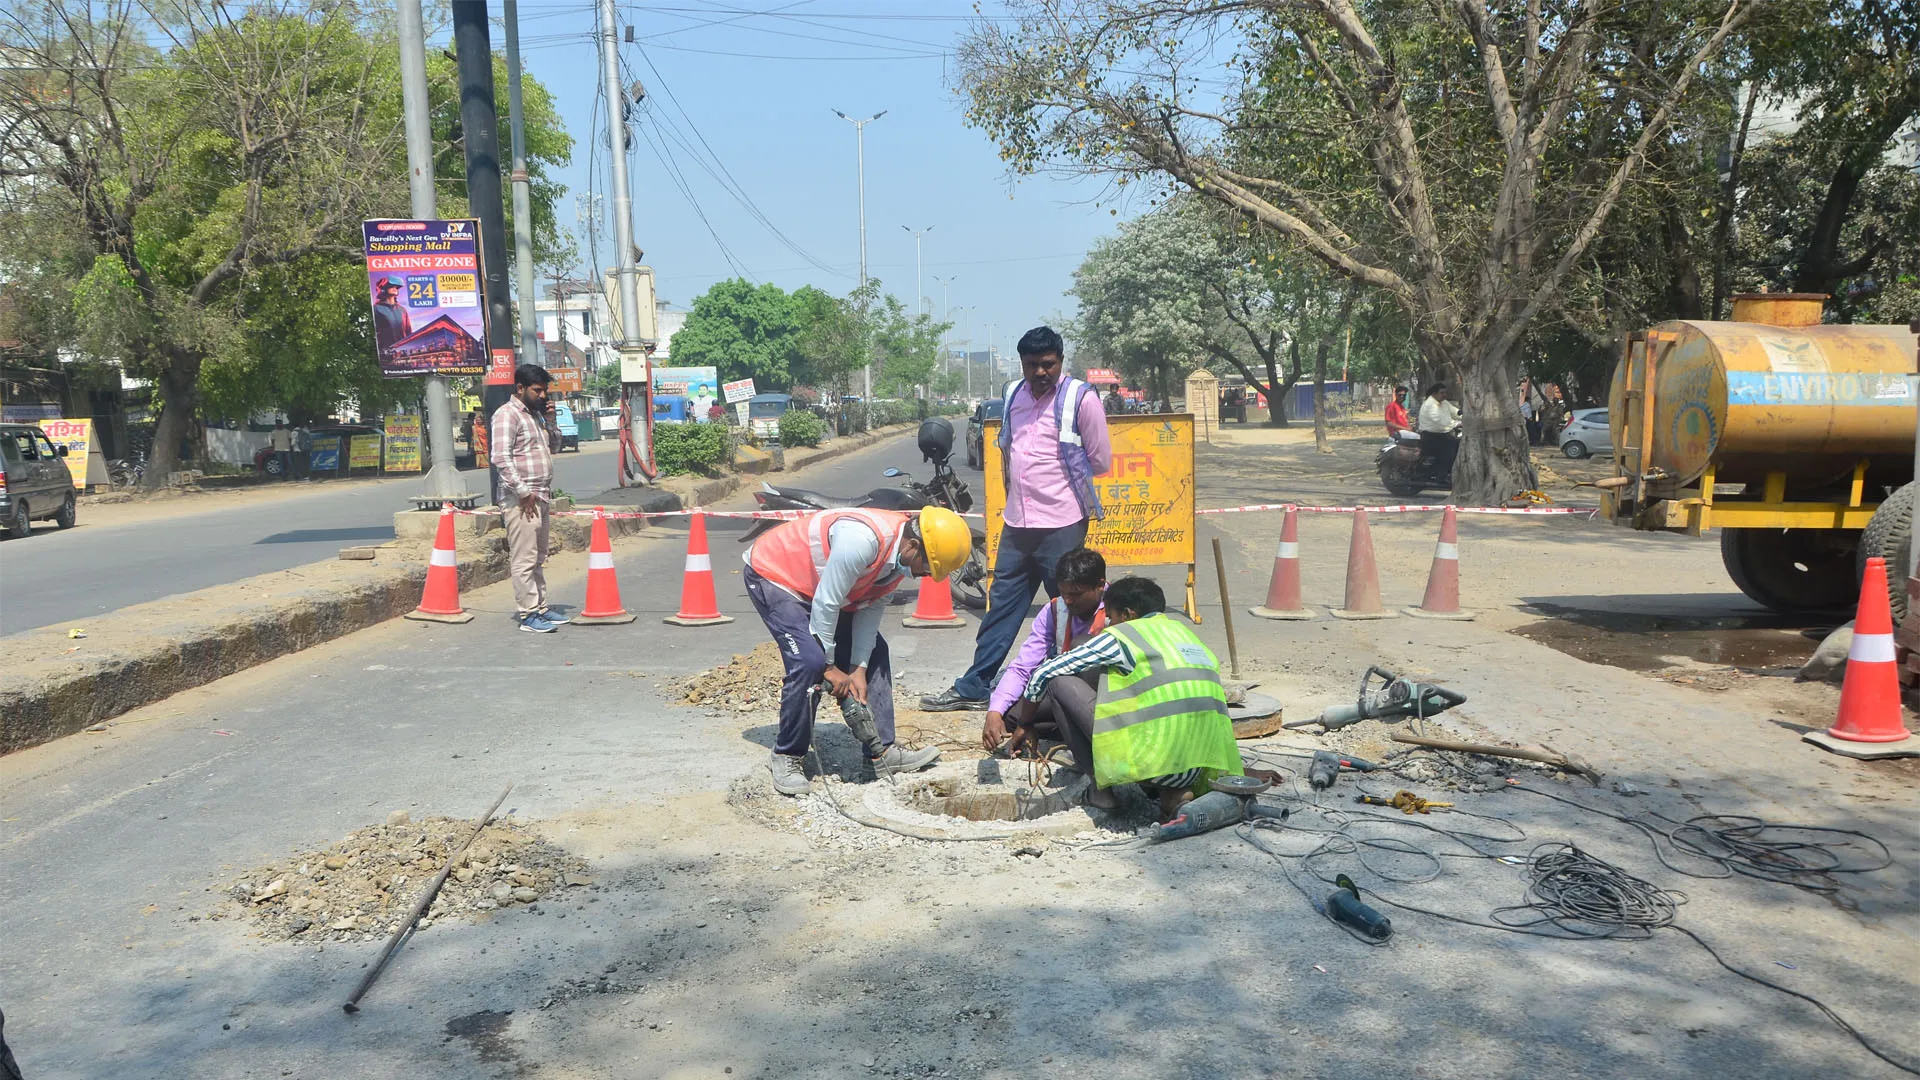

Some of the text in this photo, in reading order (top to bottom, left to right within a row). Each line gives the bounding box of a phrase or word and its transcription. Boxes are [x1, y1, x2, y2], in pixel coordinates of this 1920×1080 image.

[369, 241, 451, 252] Shopping Mall
[372, 256, 474, 269] GAMING ZONE
[409, 282, 435, 299] 24
[1763, 374, 1858, 402] ENVIRO
